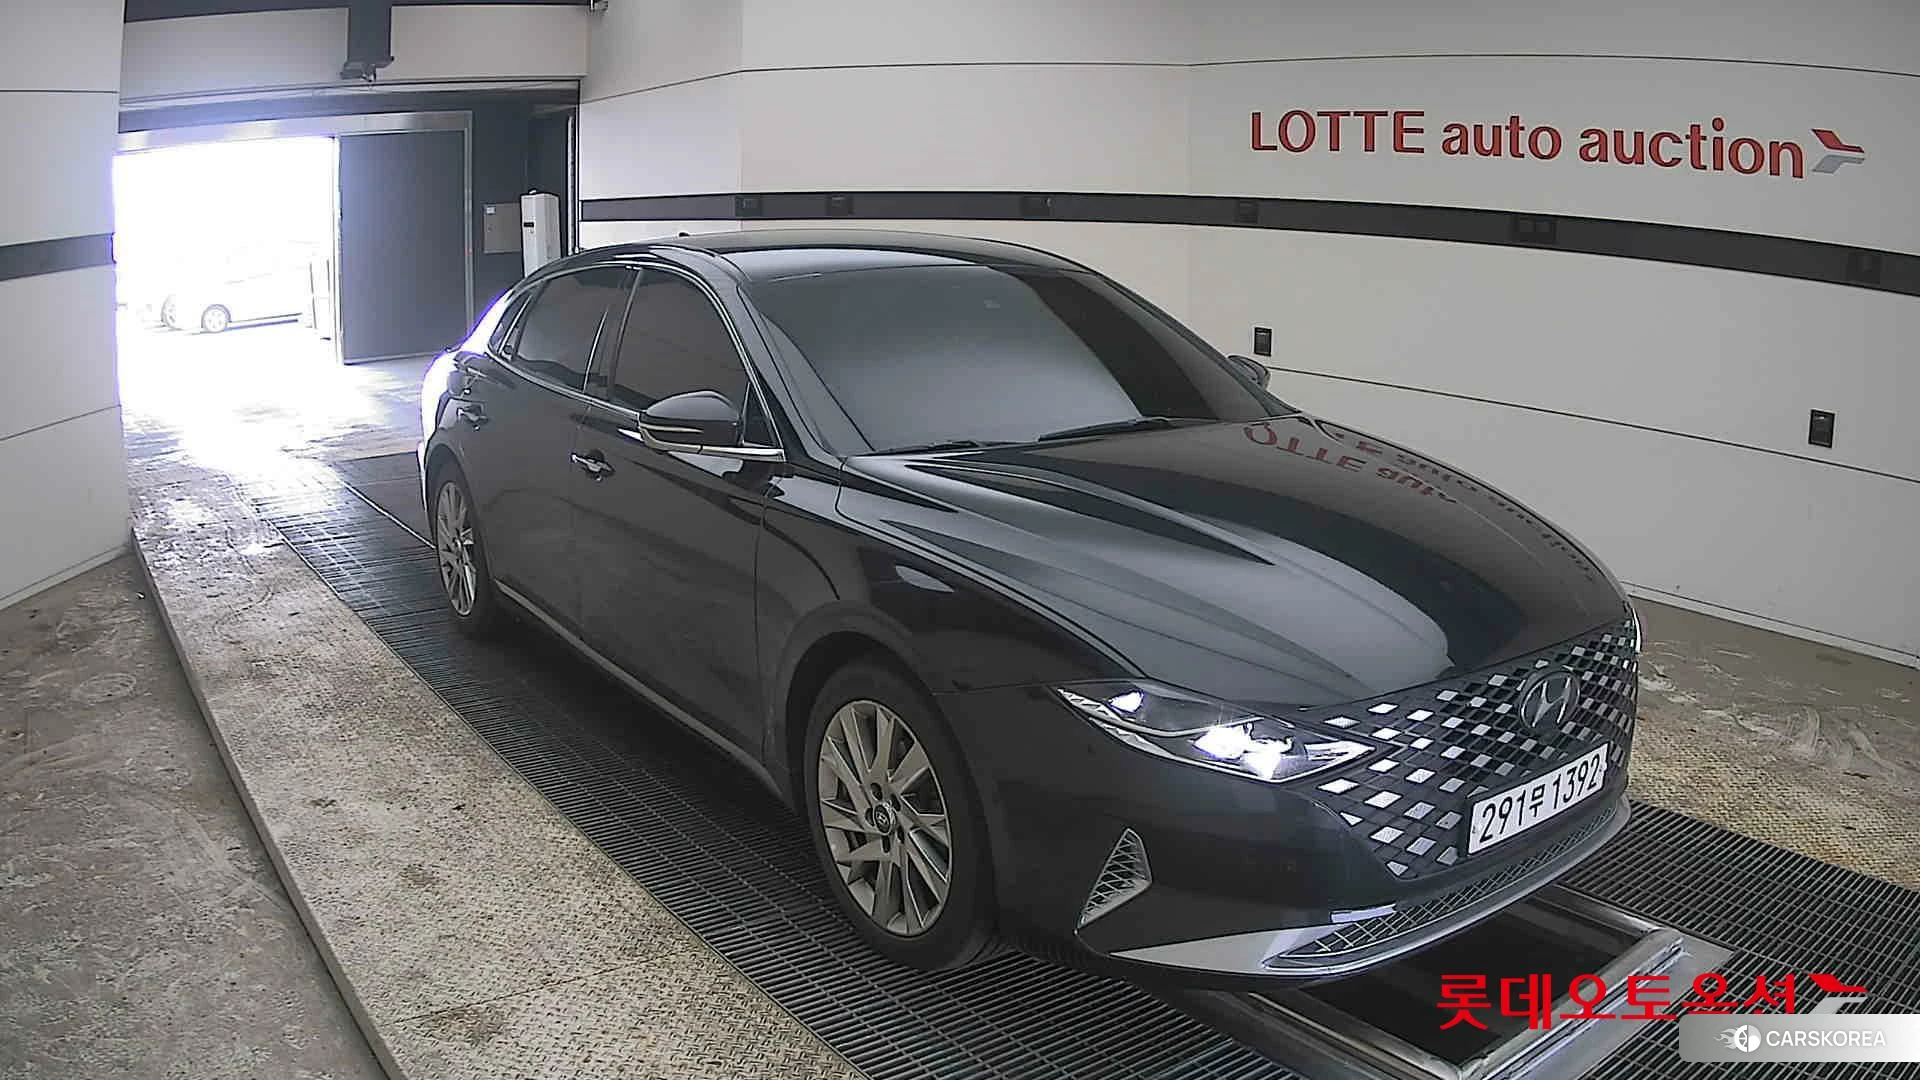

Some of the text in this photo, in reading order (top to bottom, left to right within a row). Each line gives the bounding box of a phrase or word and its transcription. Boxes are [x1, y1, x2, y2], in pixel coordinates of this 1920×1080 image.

[1250, 110, 1805, 178] LOTTE auto auction
[1479, 754, 1600, 843] 291무 1392
